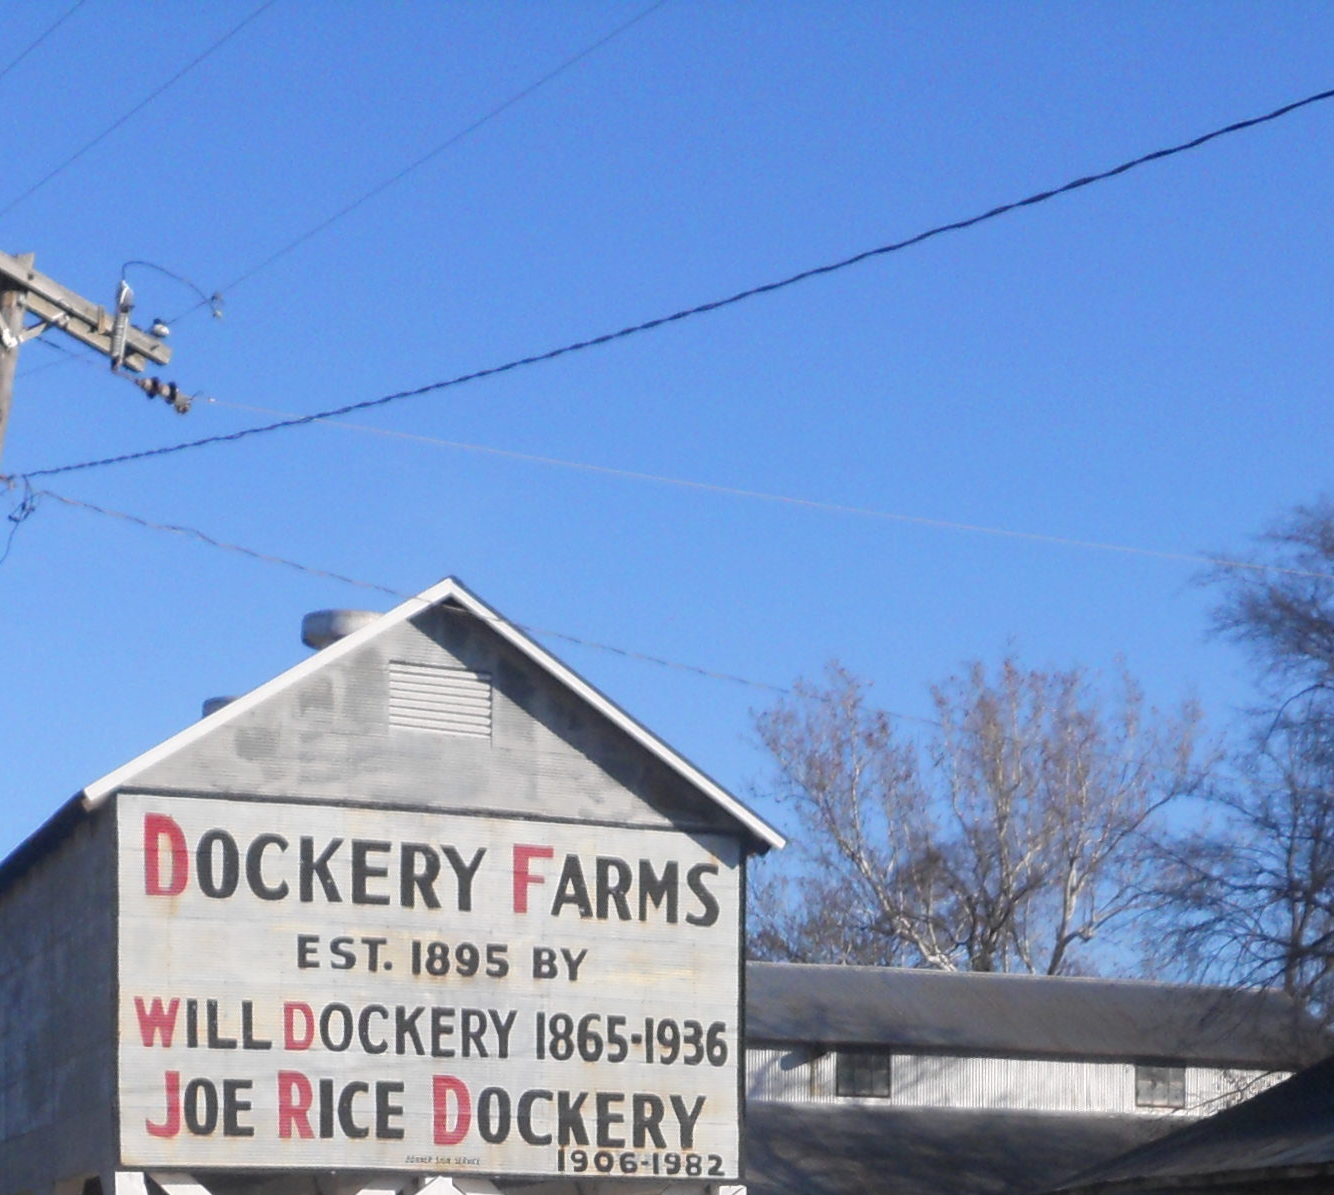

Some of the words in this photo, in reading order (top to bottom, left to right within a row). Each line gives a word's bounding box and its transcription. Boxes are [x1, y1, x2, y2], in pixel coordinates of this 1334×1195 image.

[143, 811, 487, 912] DOCKERY
[512, 842, 720, 928] FARMS
[297, 933, 393, 973] EST.
[411, 939, 509, 978] 1895
[533, 946, 588, 982] BY
[134, 996, 272, 1050] WILL
[283, 1001, 517, 1059] DOCKERY
[535, 1010, 729, 1068] 1865-1936
[146, 1070, 255, 1139] JOE
[277, 1069, 406, 1140] RICE
[432, 1074, 707, 1149] DOCKERY
[557, 1149, 725, 1177] 1906-1982
